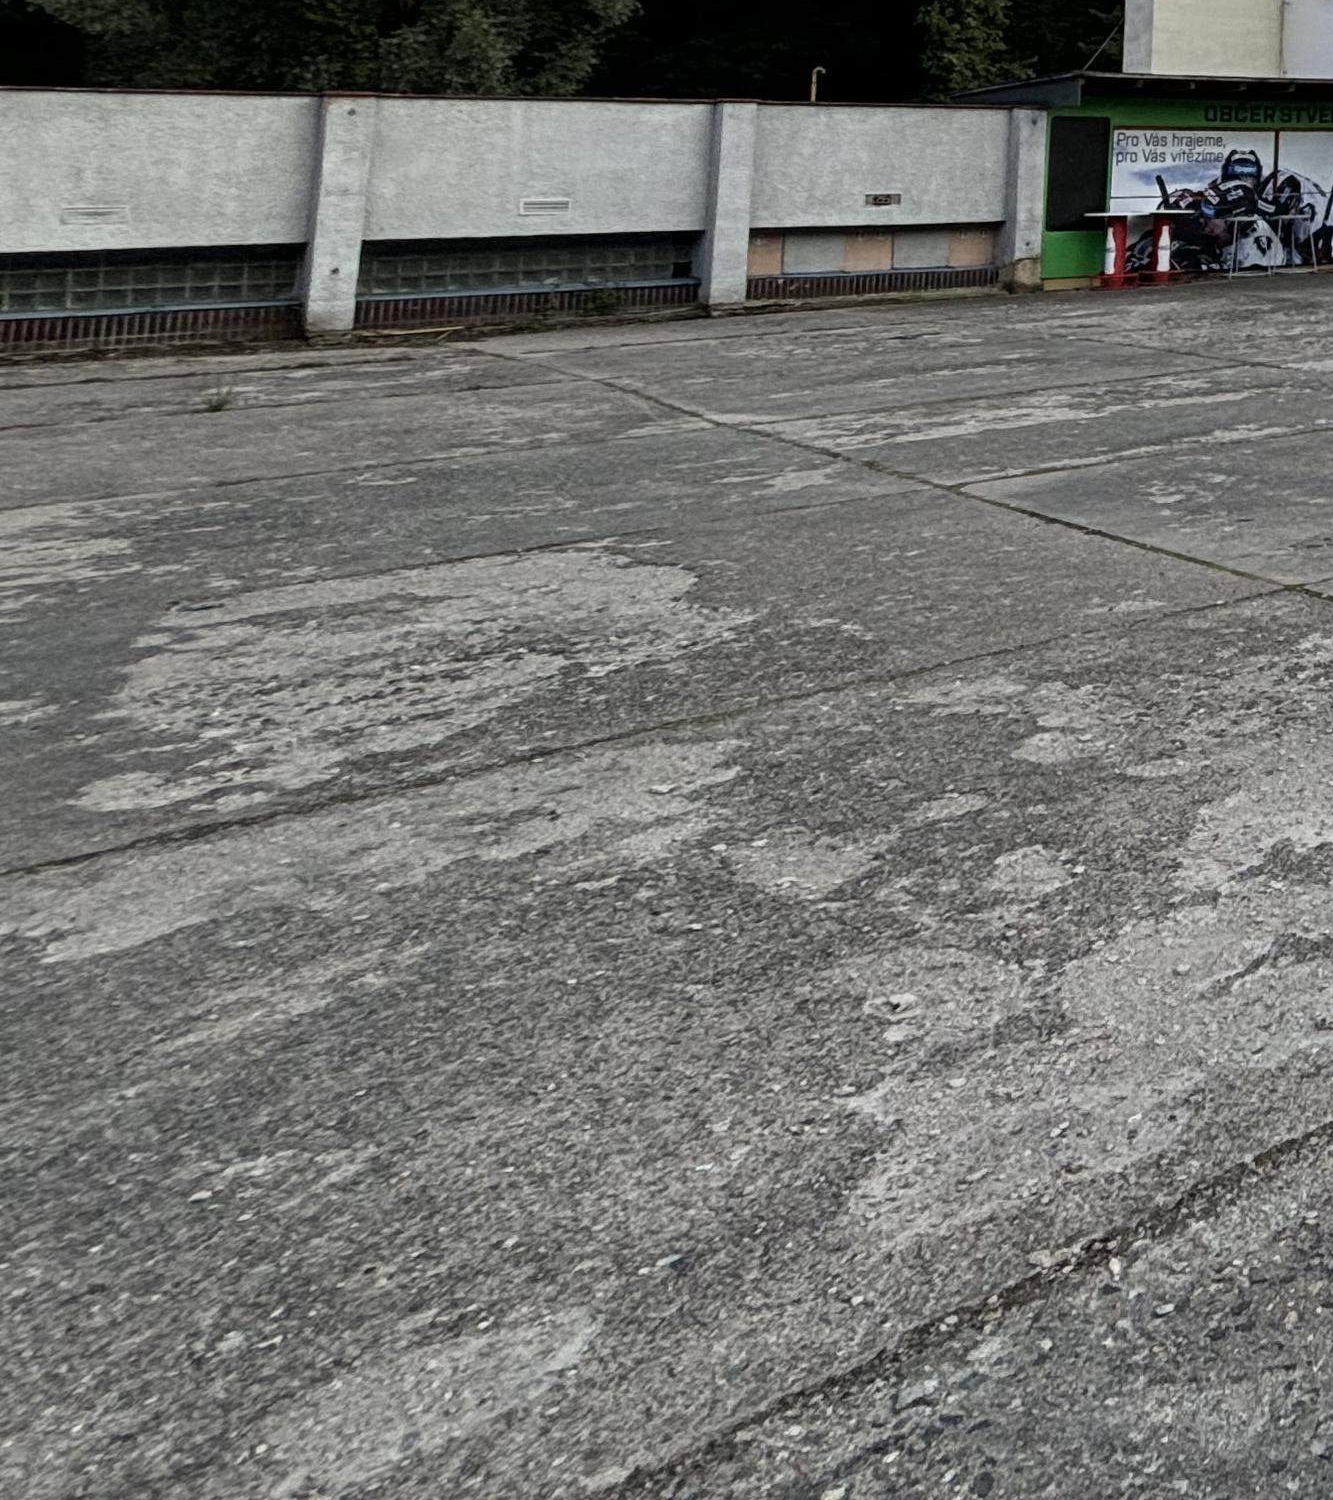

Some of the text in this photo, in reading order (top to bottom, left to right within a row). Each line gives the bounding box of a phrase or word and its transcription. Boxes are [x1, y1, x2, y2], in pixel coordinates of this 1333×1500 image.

[1116, 131, 1227, 150] Pro Vás hrajeme,
[1116, 151, 1138, 166] pro
[1142, 148, 1167, 164] Vás
